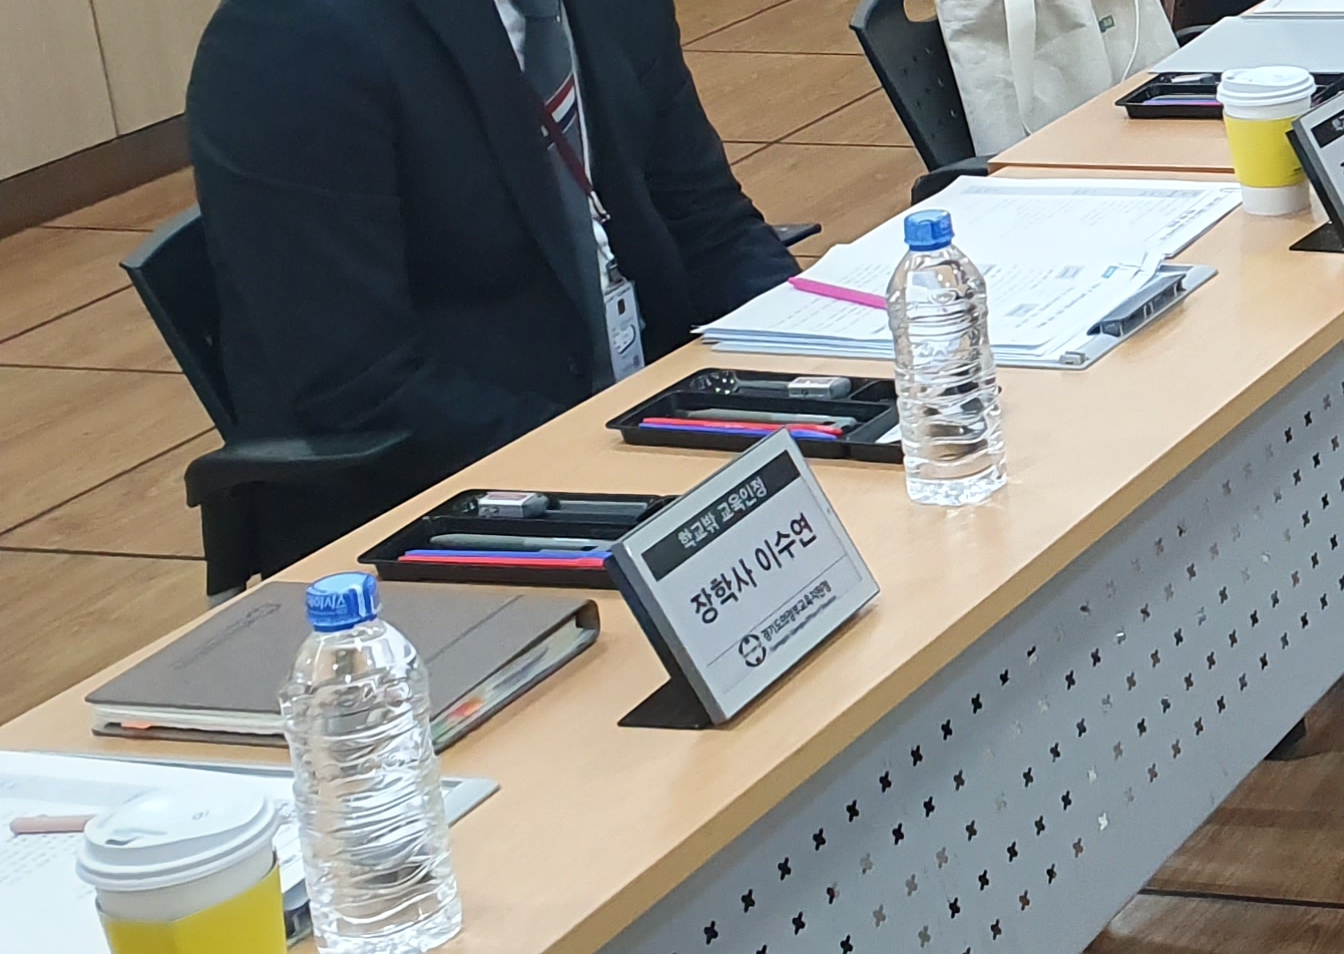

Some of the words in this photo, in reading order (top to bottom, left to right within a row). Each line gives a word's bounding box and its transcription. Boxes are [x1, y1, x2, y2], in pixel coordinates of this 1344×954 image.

[678, 511, 718, 549] 학교밖
[719, 476, 768, 524] 교육인정
[690, 558, 758, 625] 장학사
[754, 512, 818, 572] 이수연
